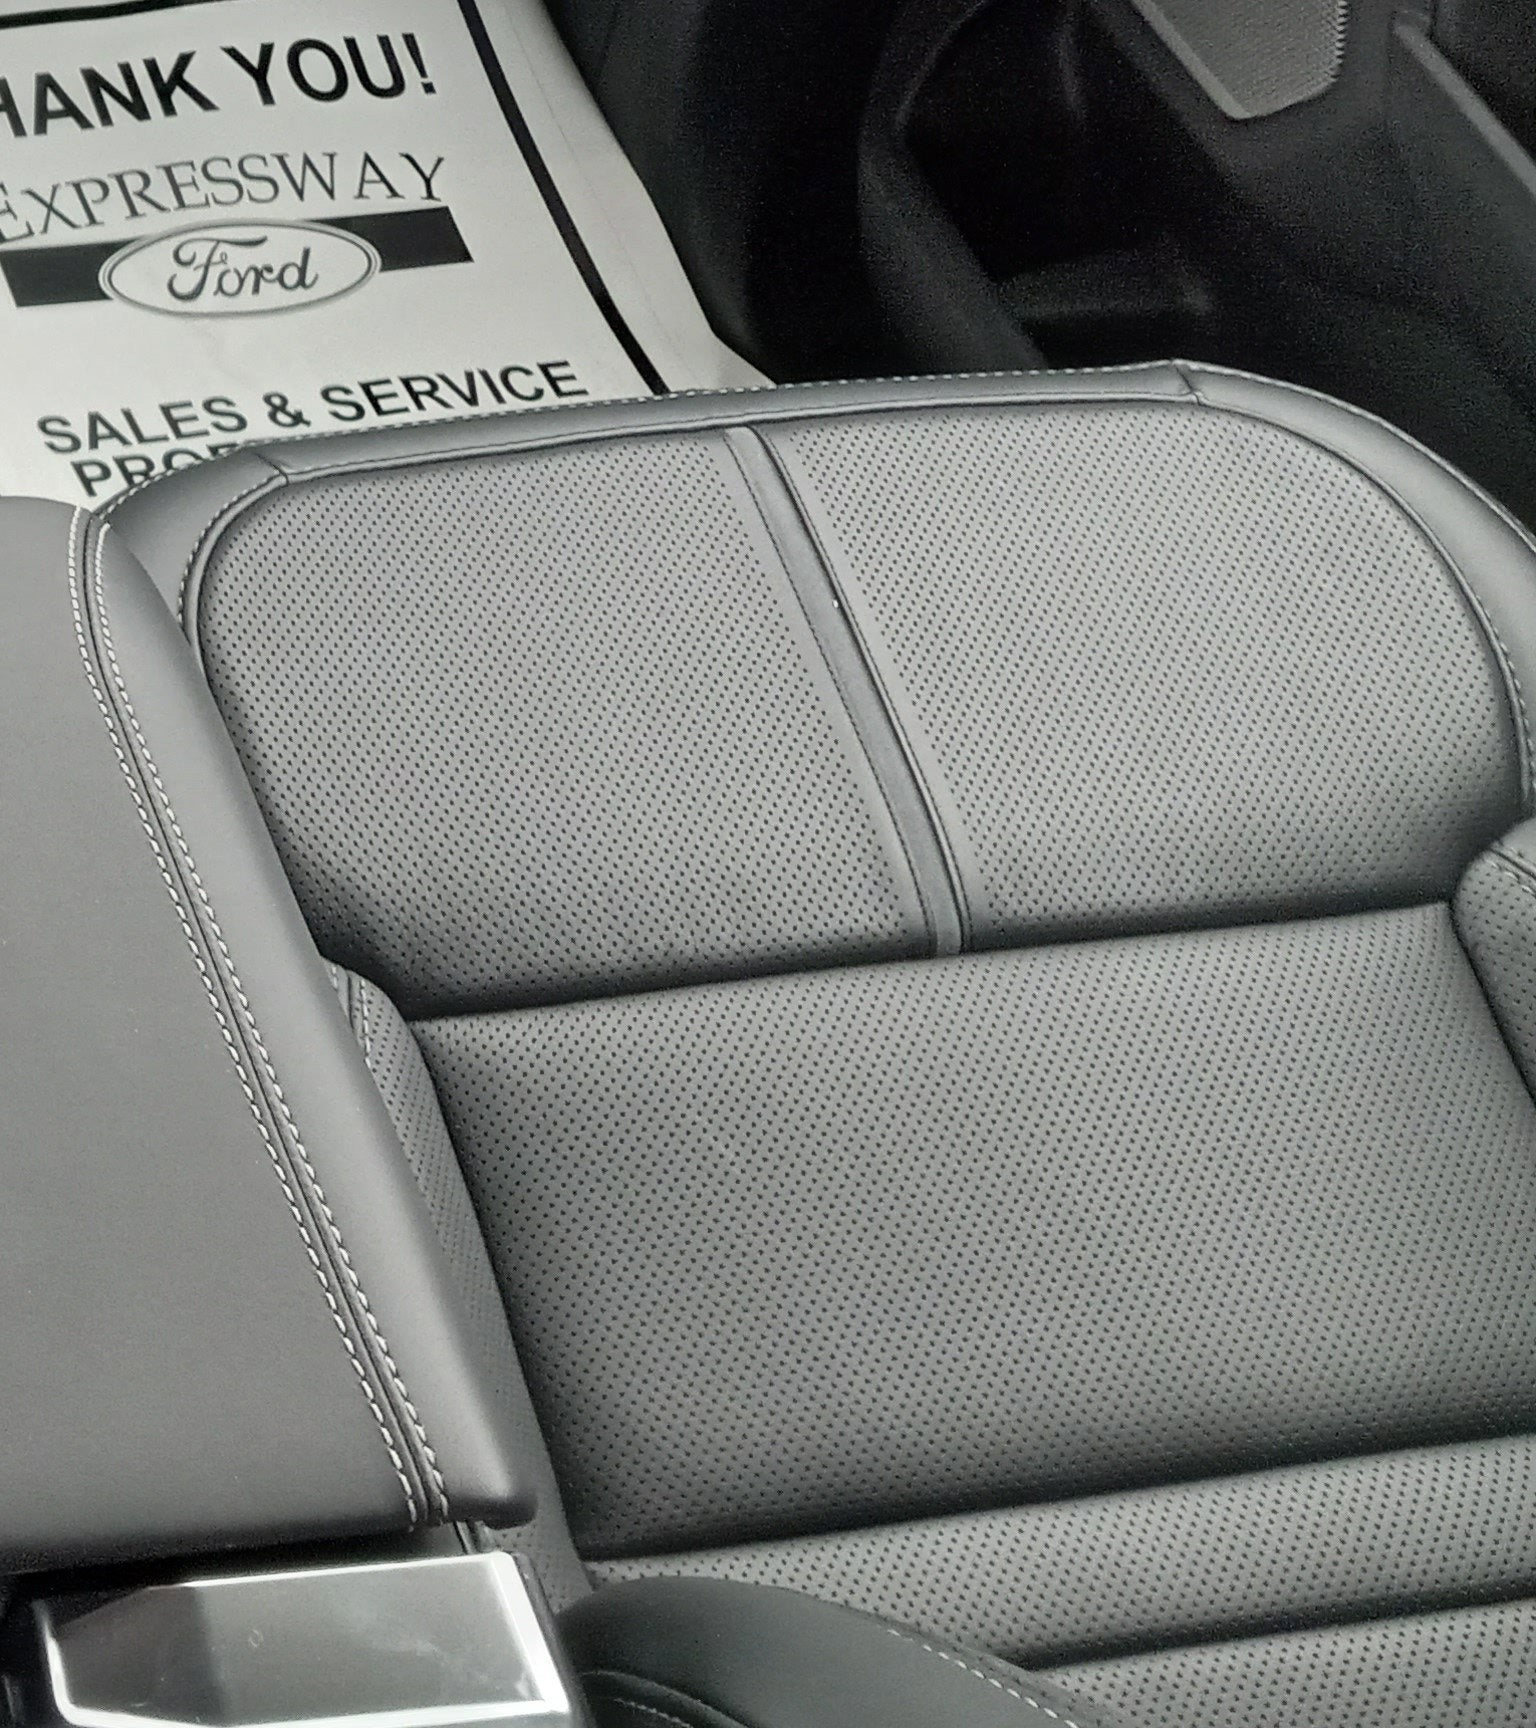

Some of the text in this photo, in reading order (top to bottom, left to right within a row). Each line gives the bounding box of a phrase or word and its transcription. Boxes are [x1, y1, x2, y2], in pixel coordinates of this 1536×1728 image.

[221, 32, 438, 106] YOU!
[167, 236, 319, 302] Ford
[37, 360, 590, 455] SALES & SERVICE
